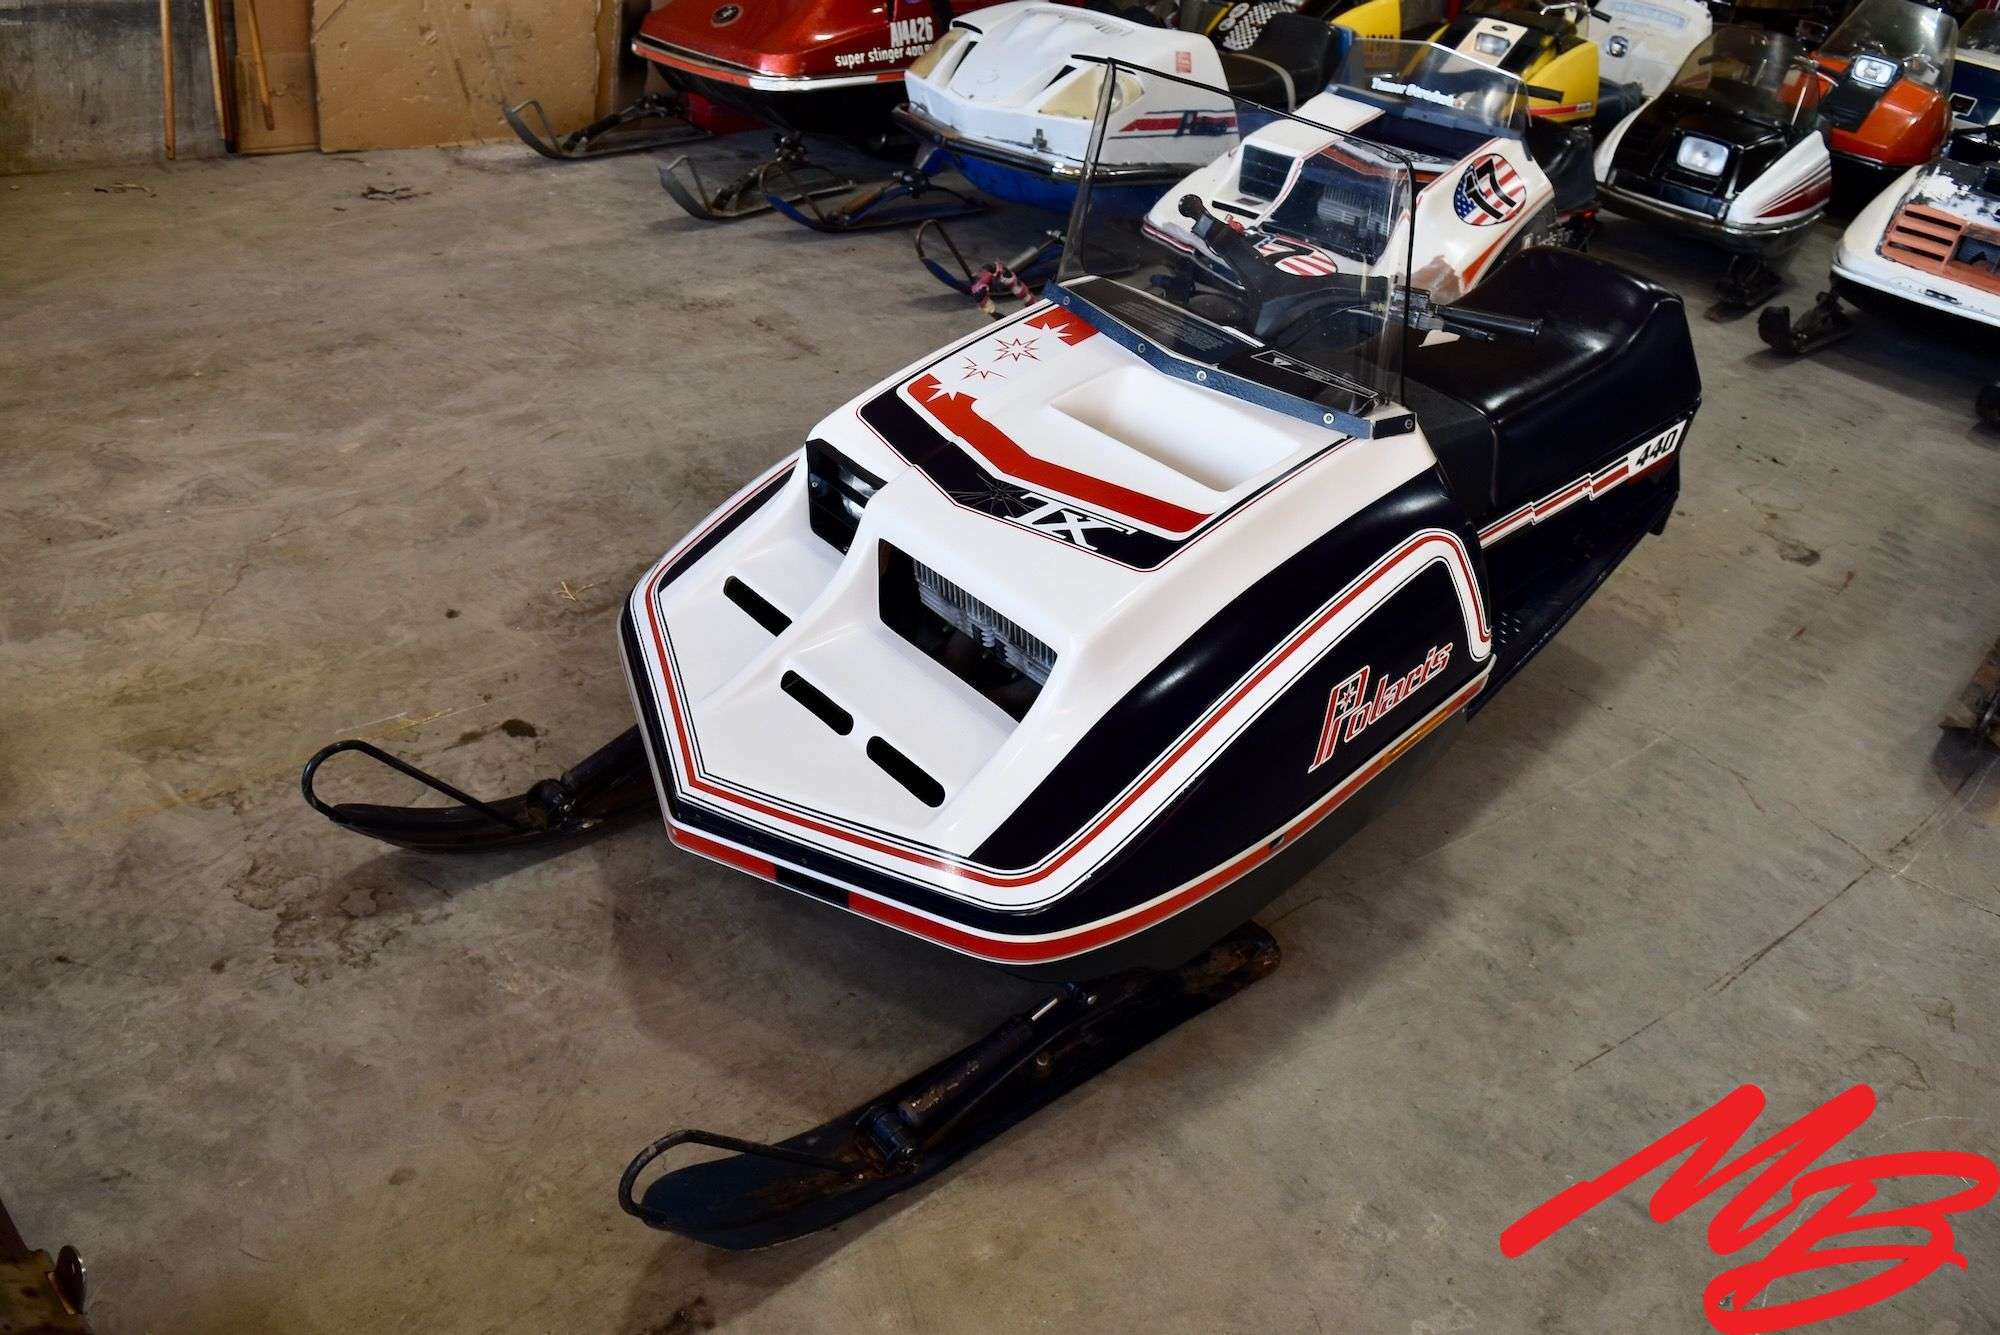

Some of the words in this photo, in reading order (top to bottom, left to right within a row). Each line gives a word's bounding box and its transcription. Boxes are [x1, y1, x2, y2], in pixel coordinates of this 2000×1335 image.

[834, 52, 866, 70] super
[867, 46, 904, 64] stinger
[1635, 428, 1679, 467] 440
[1003, 491, 1139, 551] TX
[1307, 641, 1454, 774] Polaris
